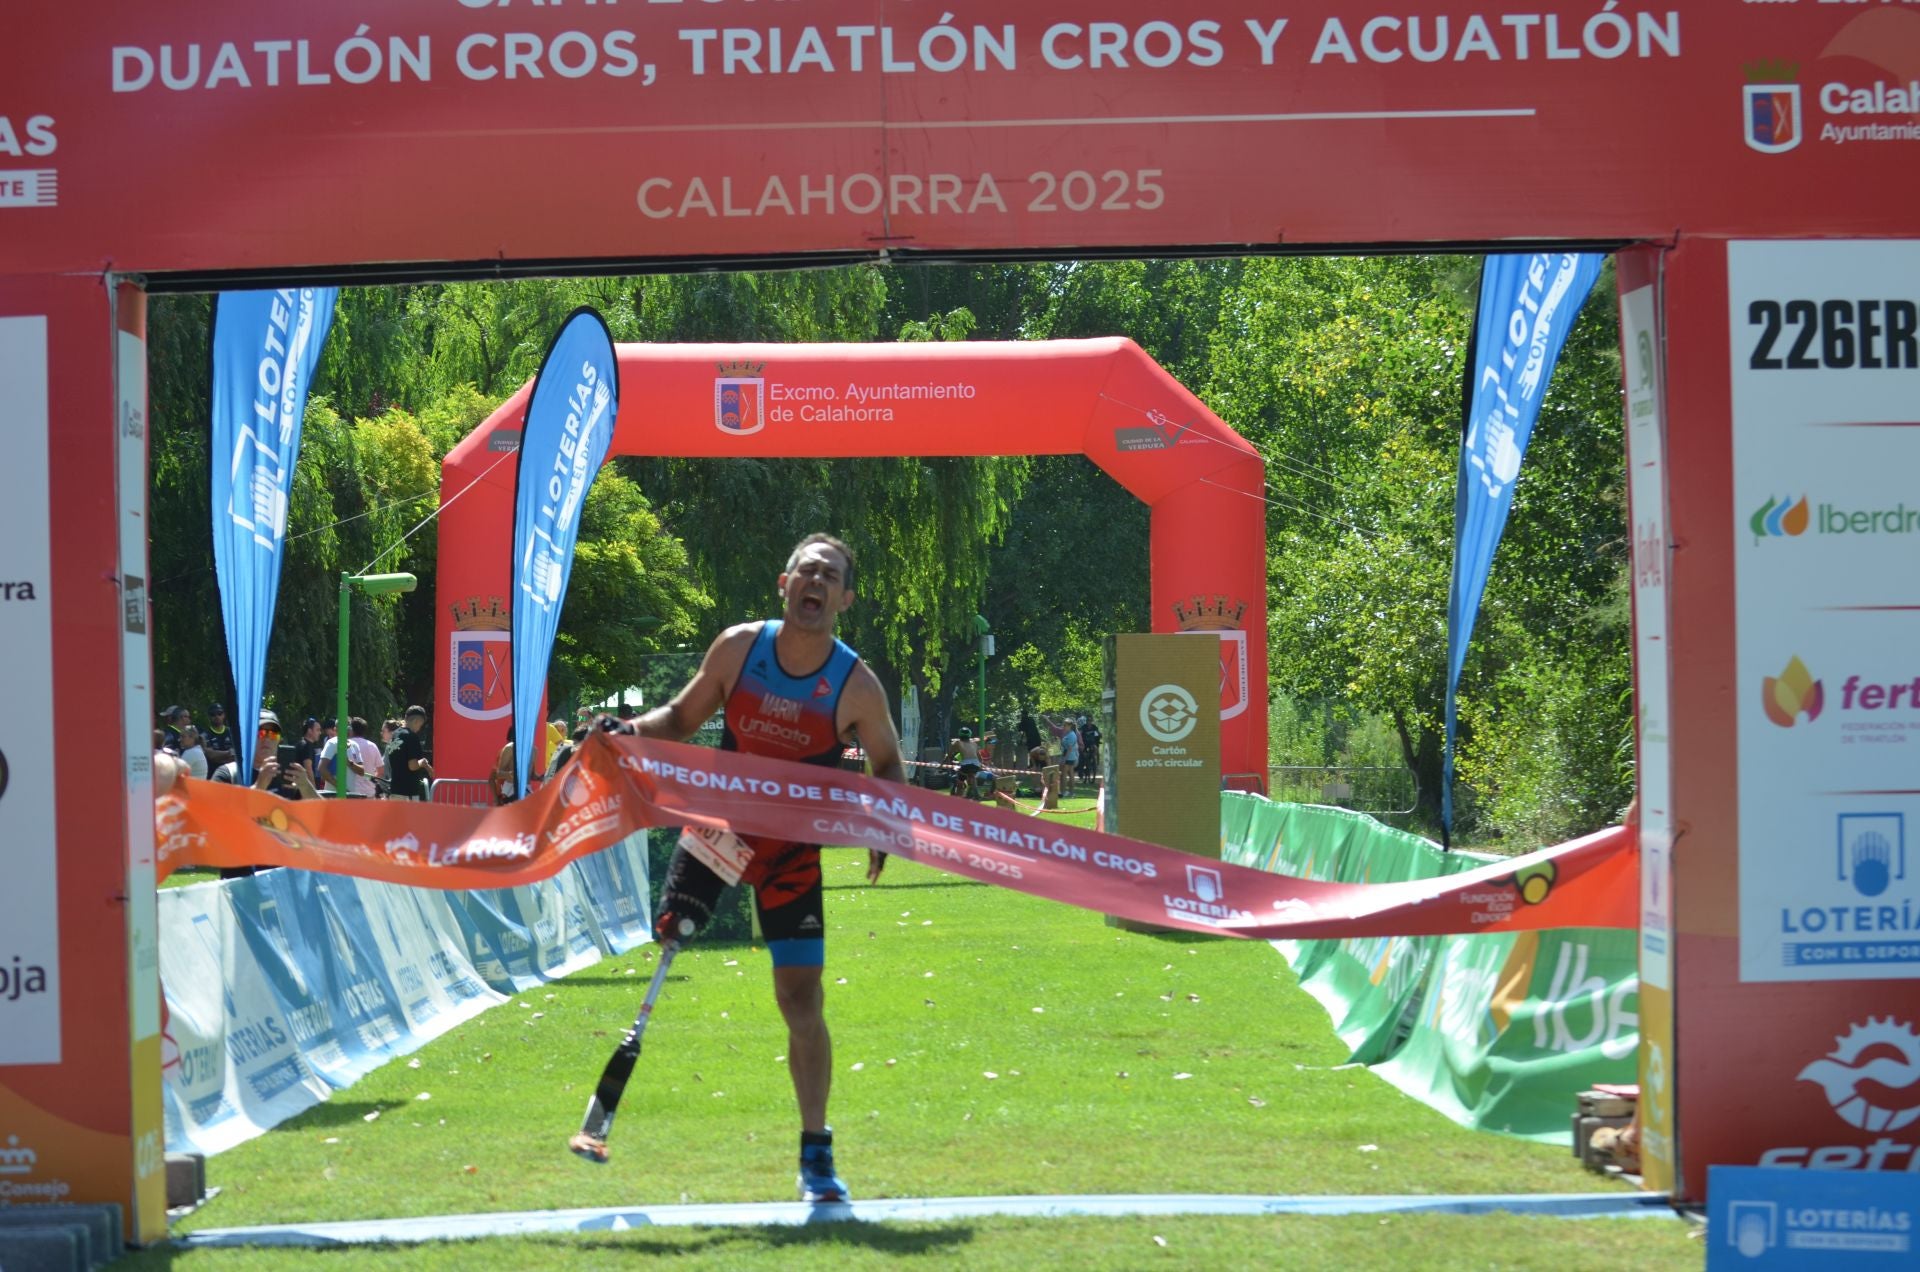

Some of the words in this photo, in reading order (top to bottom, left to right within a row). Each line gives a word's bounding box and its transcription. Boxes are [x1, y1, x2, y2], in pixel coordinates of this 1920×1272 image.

[111, 24, 431, 92] DUATLÓN
[456, 30, 656, 86] CROS,
[679, 12, 1016, 75] TRIATLÓN
[1040, 20, 1224, 69] CROS
[1244, 19, 1288, 65] Y
[1309, 3, 1681, 64] ACUATLÓN
[636, 172, 1008, 219] CALAHORRA
[1026, 169, 1165, 212] 2025
[770, 383, 840, 401] Excmo.
[845, 381, 976, 404] Ayuntamiento
[770, 406, 795, 422] de
[800, 405, 894, 422] Calahorra
[542, 360, 598, 520] LOTERÍAS
[1819, 503, 1920, 534] Iberdr
[1135, 758, 1163, 768] 100%
[1164, 757, 1204, 767] circular
[1152, 745, 1186, 755] Cartón
[619, 755, 782, 797] CAMPEONATO
[788, 783, 823, 801] DE
[830, 788, 926, 824] ESPAÑA
[932, 811, 965, 834] DE
[970, 819, 1087, 863] TRIATLÓN
[1093, 850, 1158, 878] CROS
[428, 842, 459, 867] La
[812, 818, 963, 864] CALAHORRA
[968, 853, 1024, 880] 2025
[1782, 899, 1920, 933] LOTERÍ
[1786, 1206, 1911, 1231] LOTERÍAS
